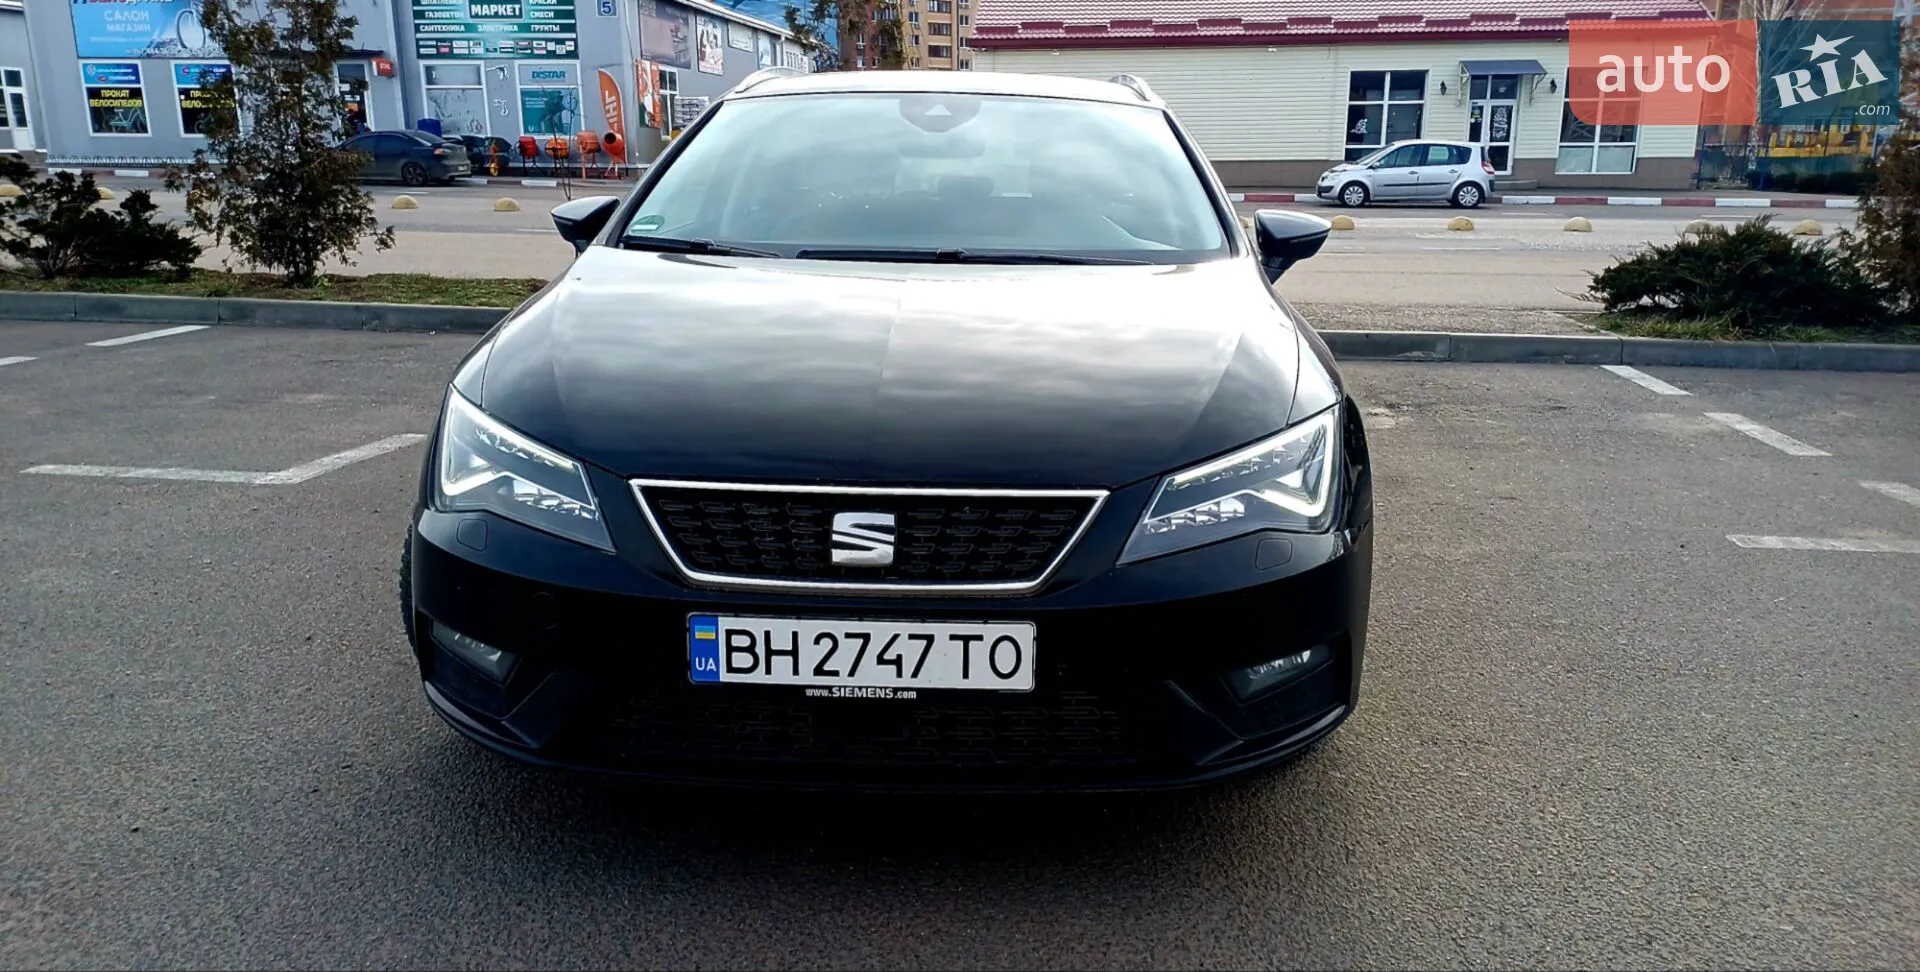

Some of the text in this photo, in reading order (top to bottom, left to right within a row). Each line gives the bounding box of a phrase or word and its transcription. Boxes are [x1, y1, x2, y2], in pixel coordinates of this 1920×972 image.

[471, 4, 521, 16] МАРКЕТ
[602, 1, 612, 14] 5
[104, 10, 149, 21] САЛОН
[106, 23, 150, 32] МАГАЗИН
[419, 24, 465, 32] САНТЕХНИКА
[101, 89, 130, 98] ПРОКАТ
[89, 99, 142, 107] ВЕЛОСИПЕДОВ
[725, 628, 1023, 680] BH 2747 TO
[695, 657, 717, 672] UA
[805, 686, 917, 700] www.SIEMENS.com
